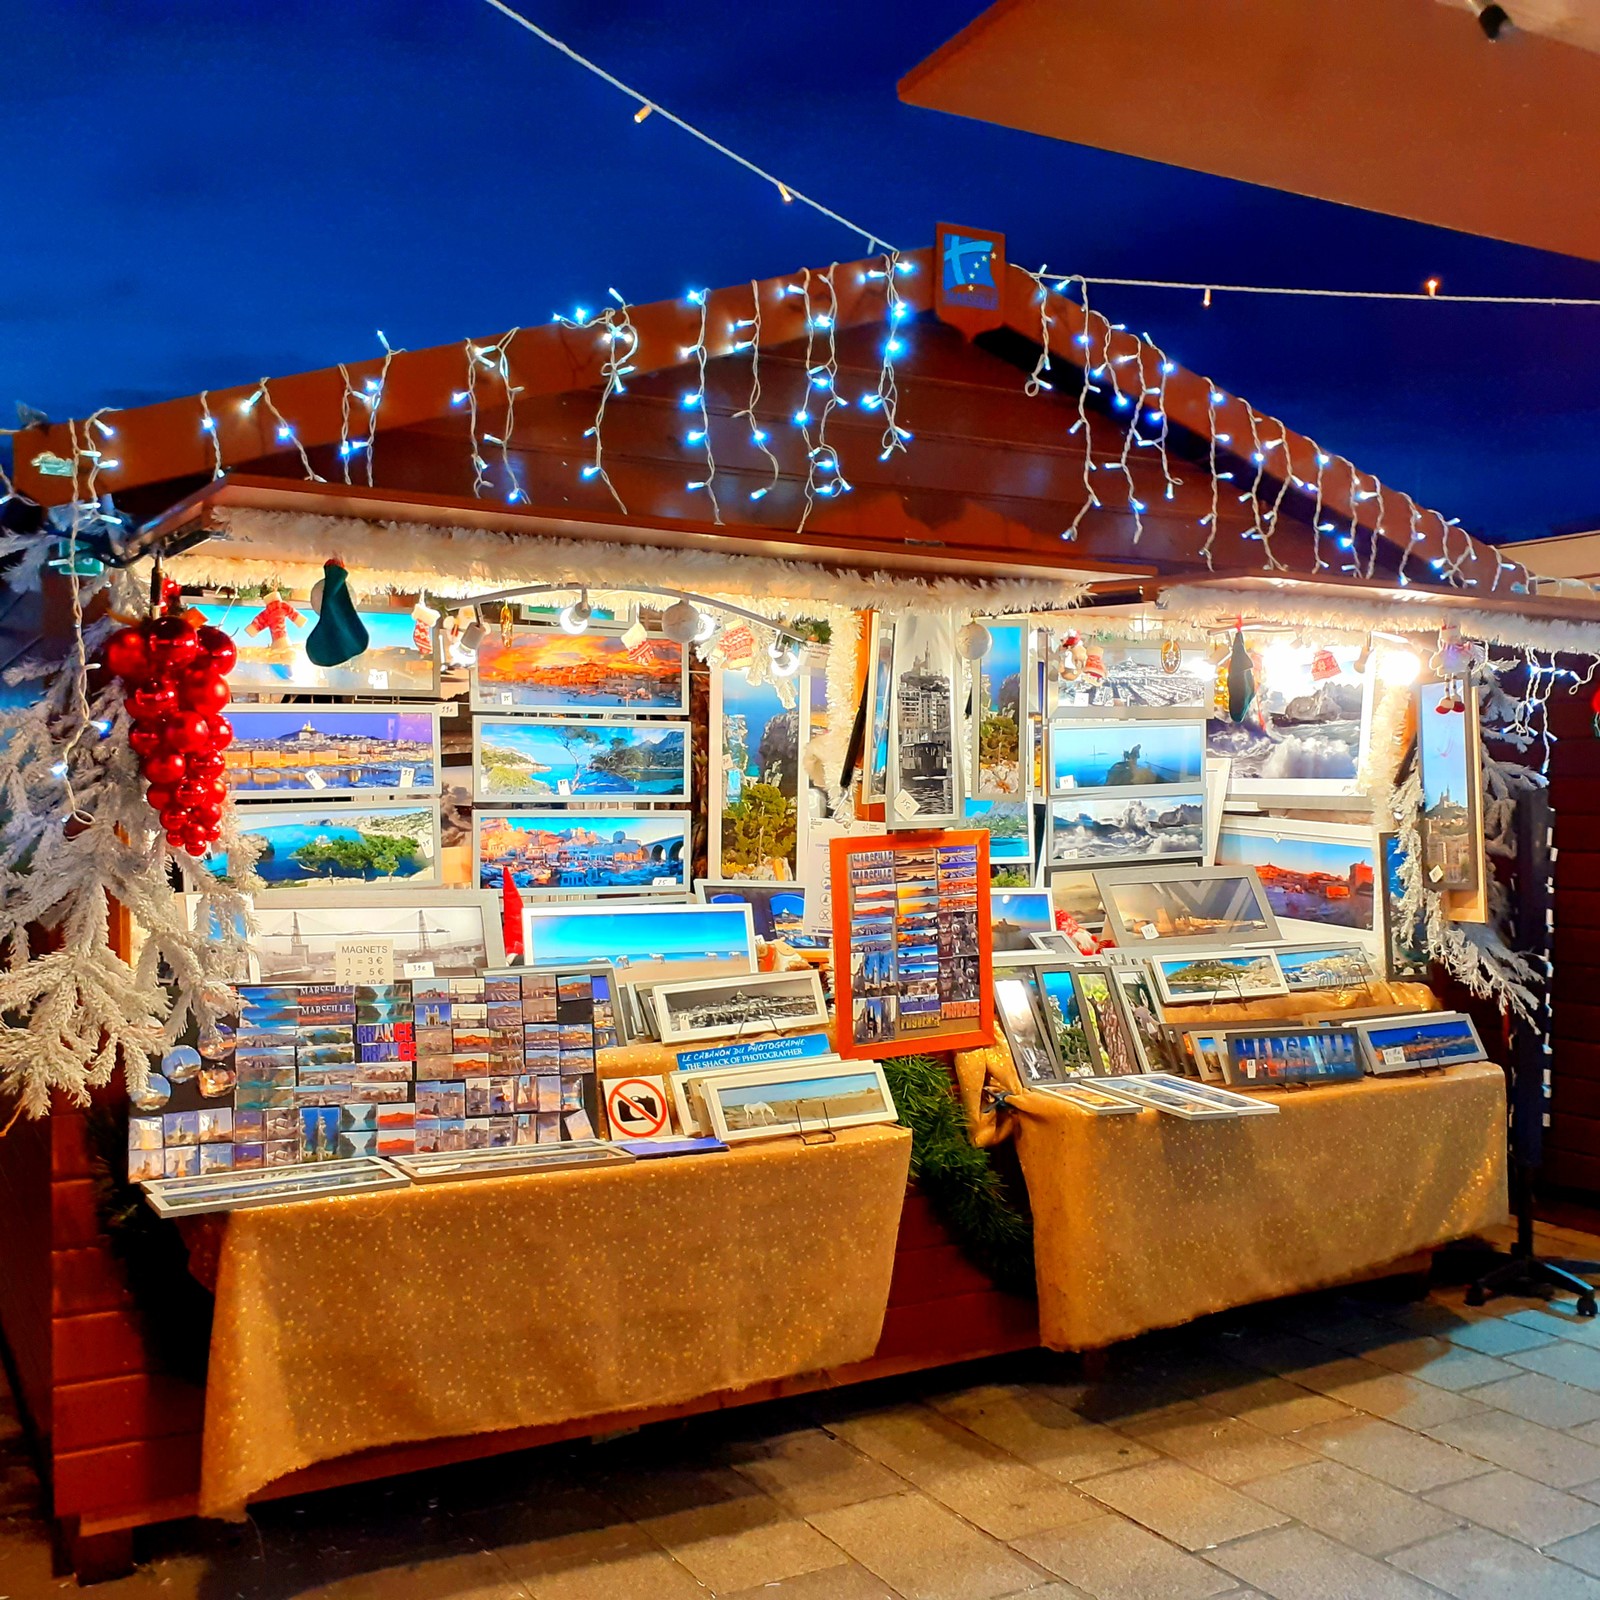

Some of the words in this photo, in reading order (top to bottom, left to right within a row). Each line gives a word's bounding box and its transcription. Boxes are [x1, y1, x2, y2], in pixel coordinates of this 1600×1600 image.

[341, 945, 388, 954] MAGNETS
[367, 956, 374, 965] 3
[376, 956, 383, 965] €
[345, 968, 351, 976] 2
[369, 968, 375, 976] 5
[377, 967, 384, 976] €
[300, 985, 350, 996] MARSEILLE
[301, 1004, 351, 1016] MARSEILLE
[357, 1022, 413, 1044] FRANCE
[682, 1054, 692, 1062] LE
[693, 1048, 731, 1061] CABANON
[733, 1046, 745, 1055] DU
[747, 1038, 806, 1053] PHOTOGRAPHE
[685, 1062, 701, 1071] THE
[702, 1057, 730, 1069] SHACK
[730, 1056, 742, 1064] OF
[742, 1047, 803, 1062] PHOTOGRAPHER
